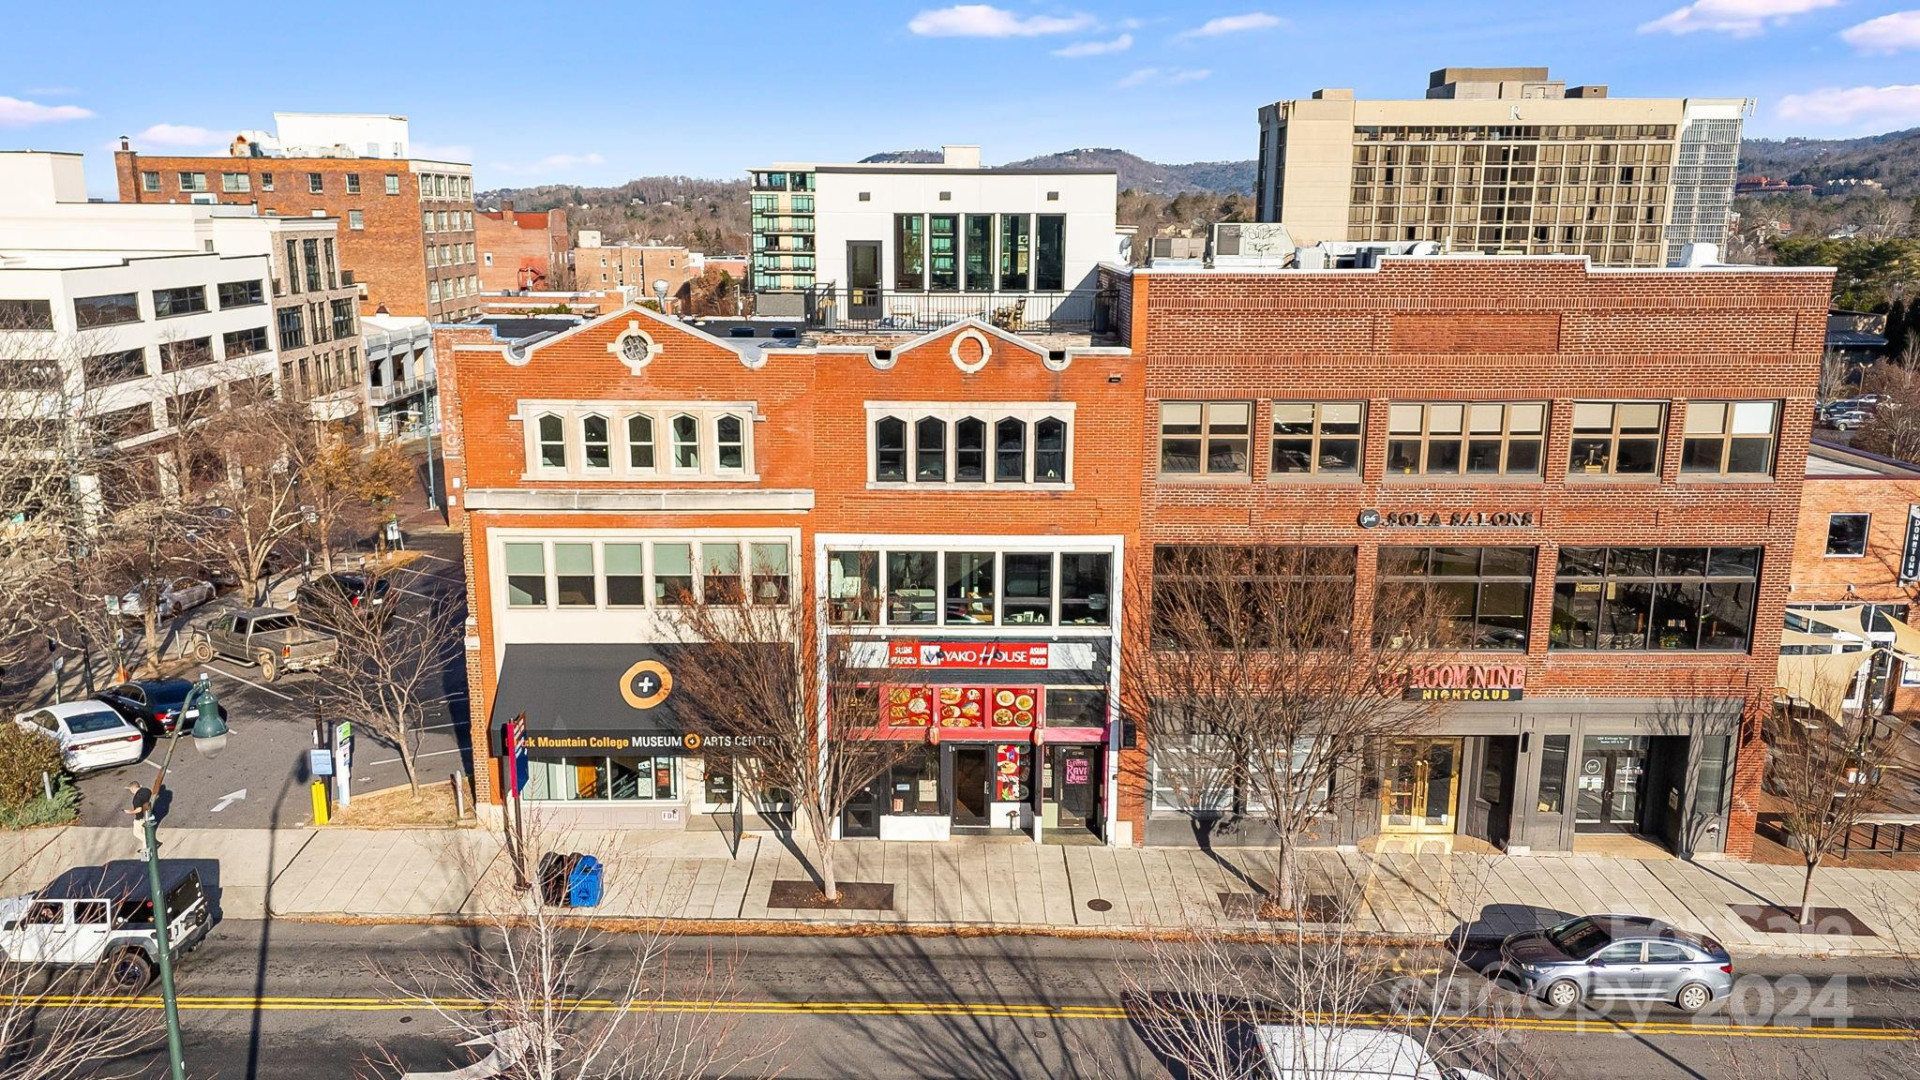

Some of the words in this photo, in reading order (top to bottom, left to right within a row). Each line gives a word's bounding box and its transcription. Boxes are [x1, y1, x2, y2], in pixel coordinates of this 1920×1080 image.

[1388, 512, 1442, 527] SOLA
[1451, 512, 1534, 527] SALONS
[1473, 666, 1527, 689] NINE
[1422, 689, 1510, 701] NIGHTCLUB
[537, 736, 588, 748] Mountain
[589, 736, 629, 750] College
[631, 736, 682, 747] MUSEUM
[703, 736, 732, 747] ARTS
